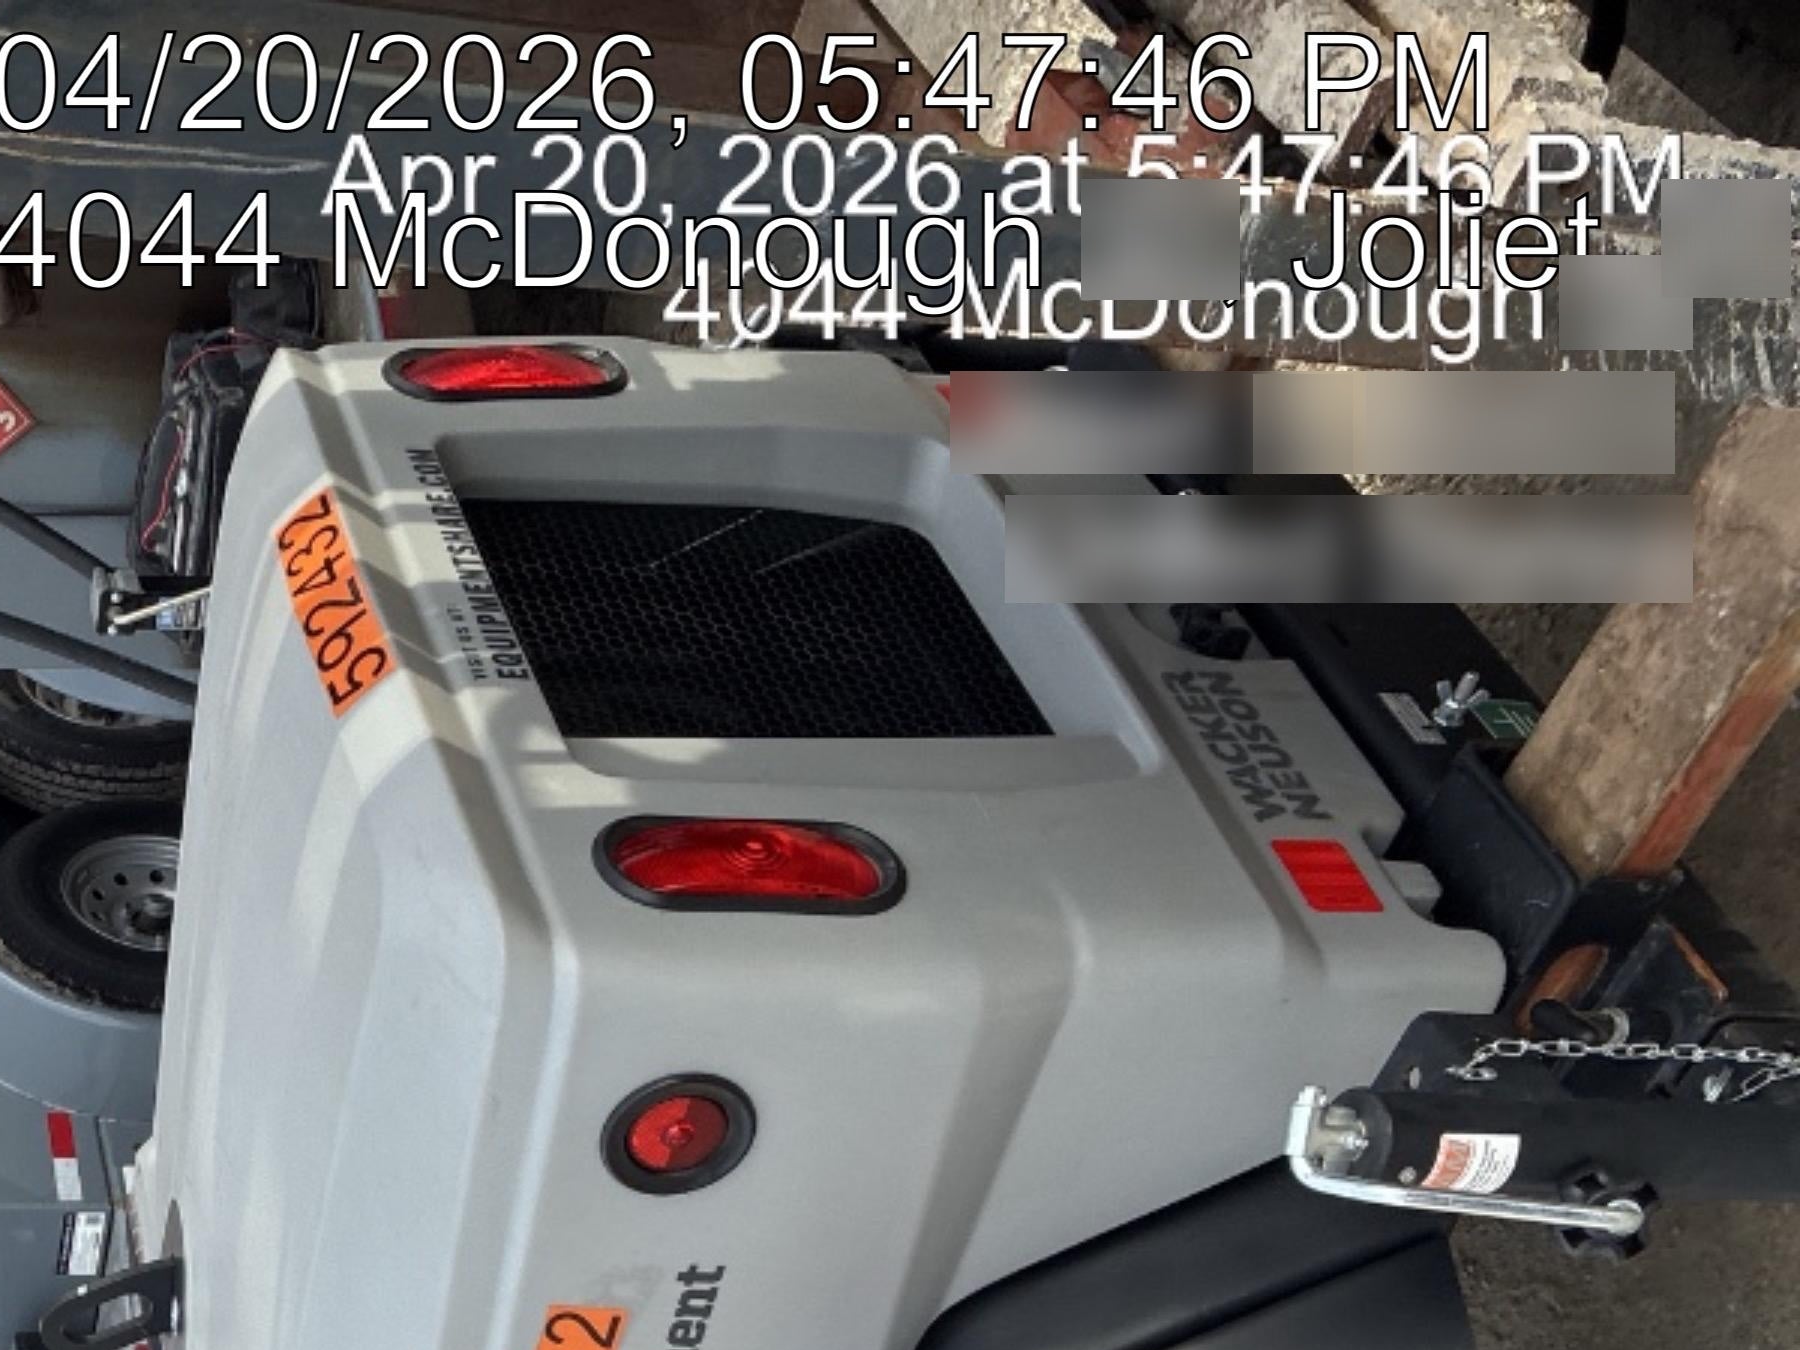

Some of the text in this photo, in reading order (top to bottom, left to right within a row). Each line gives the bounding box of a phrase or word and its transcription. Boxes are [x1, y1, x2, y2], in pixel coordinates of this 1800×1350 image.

[278, 494, 388, 706] 592432
[404, 448, 529, 681] EQUIPMENTSHARE.COM
[1161, 670, 1287, 823] WACKER
[1196, 671, 1334, 820] NEUSON
